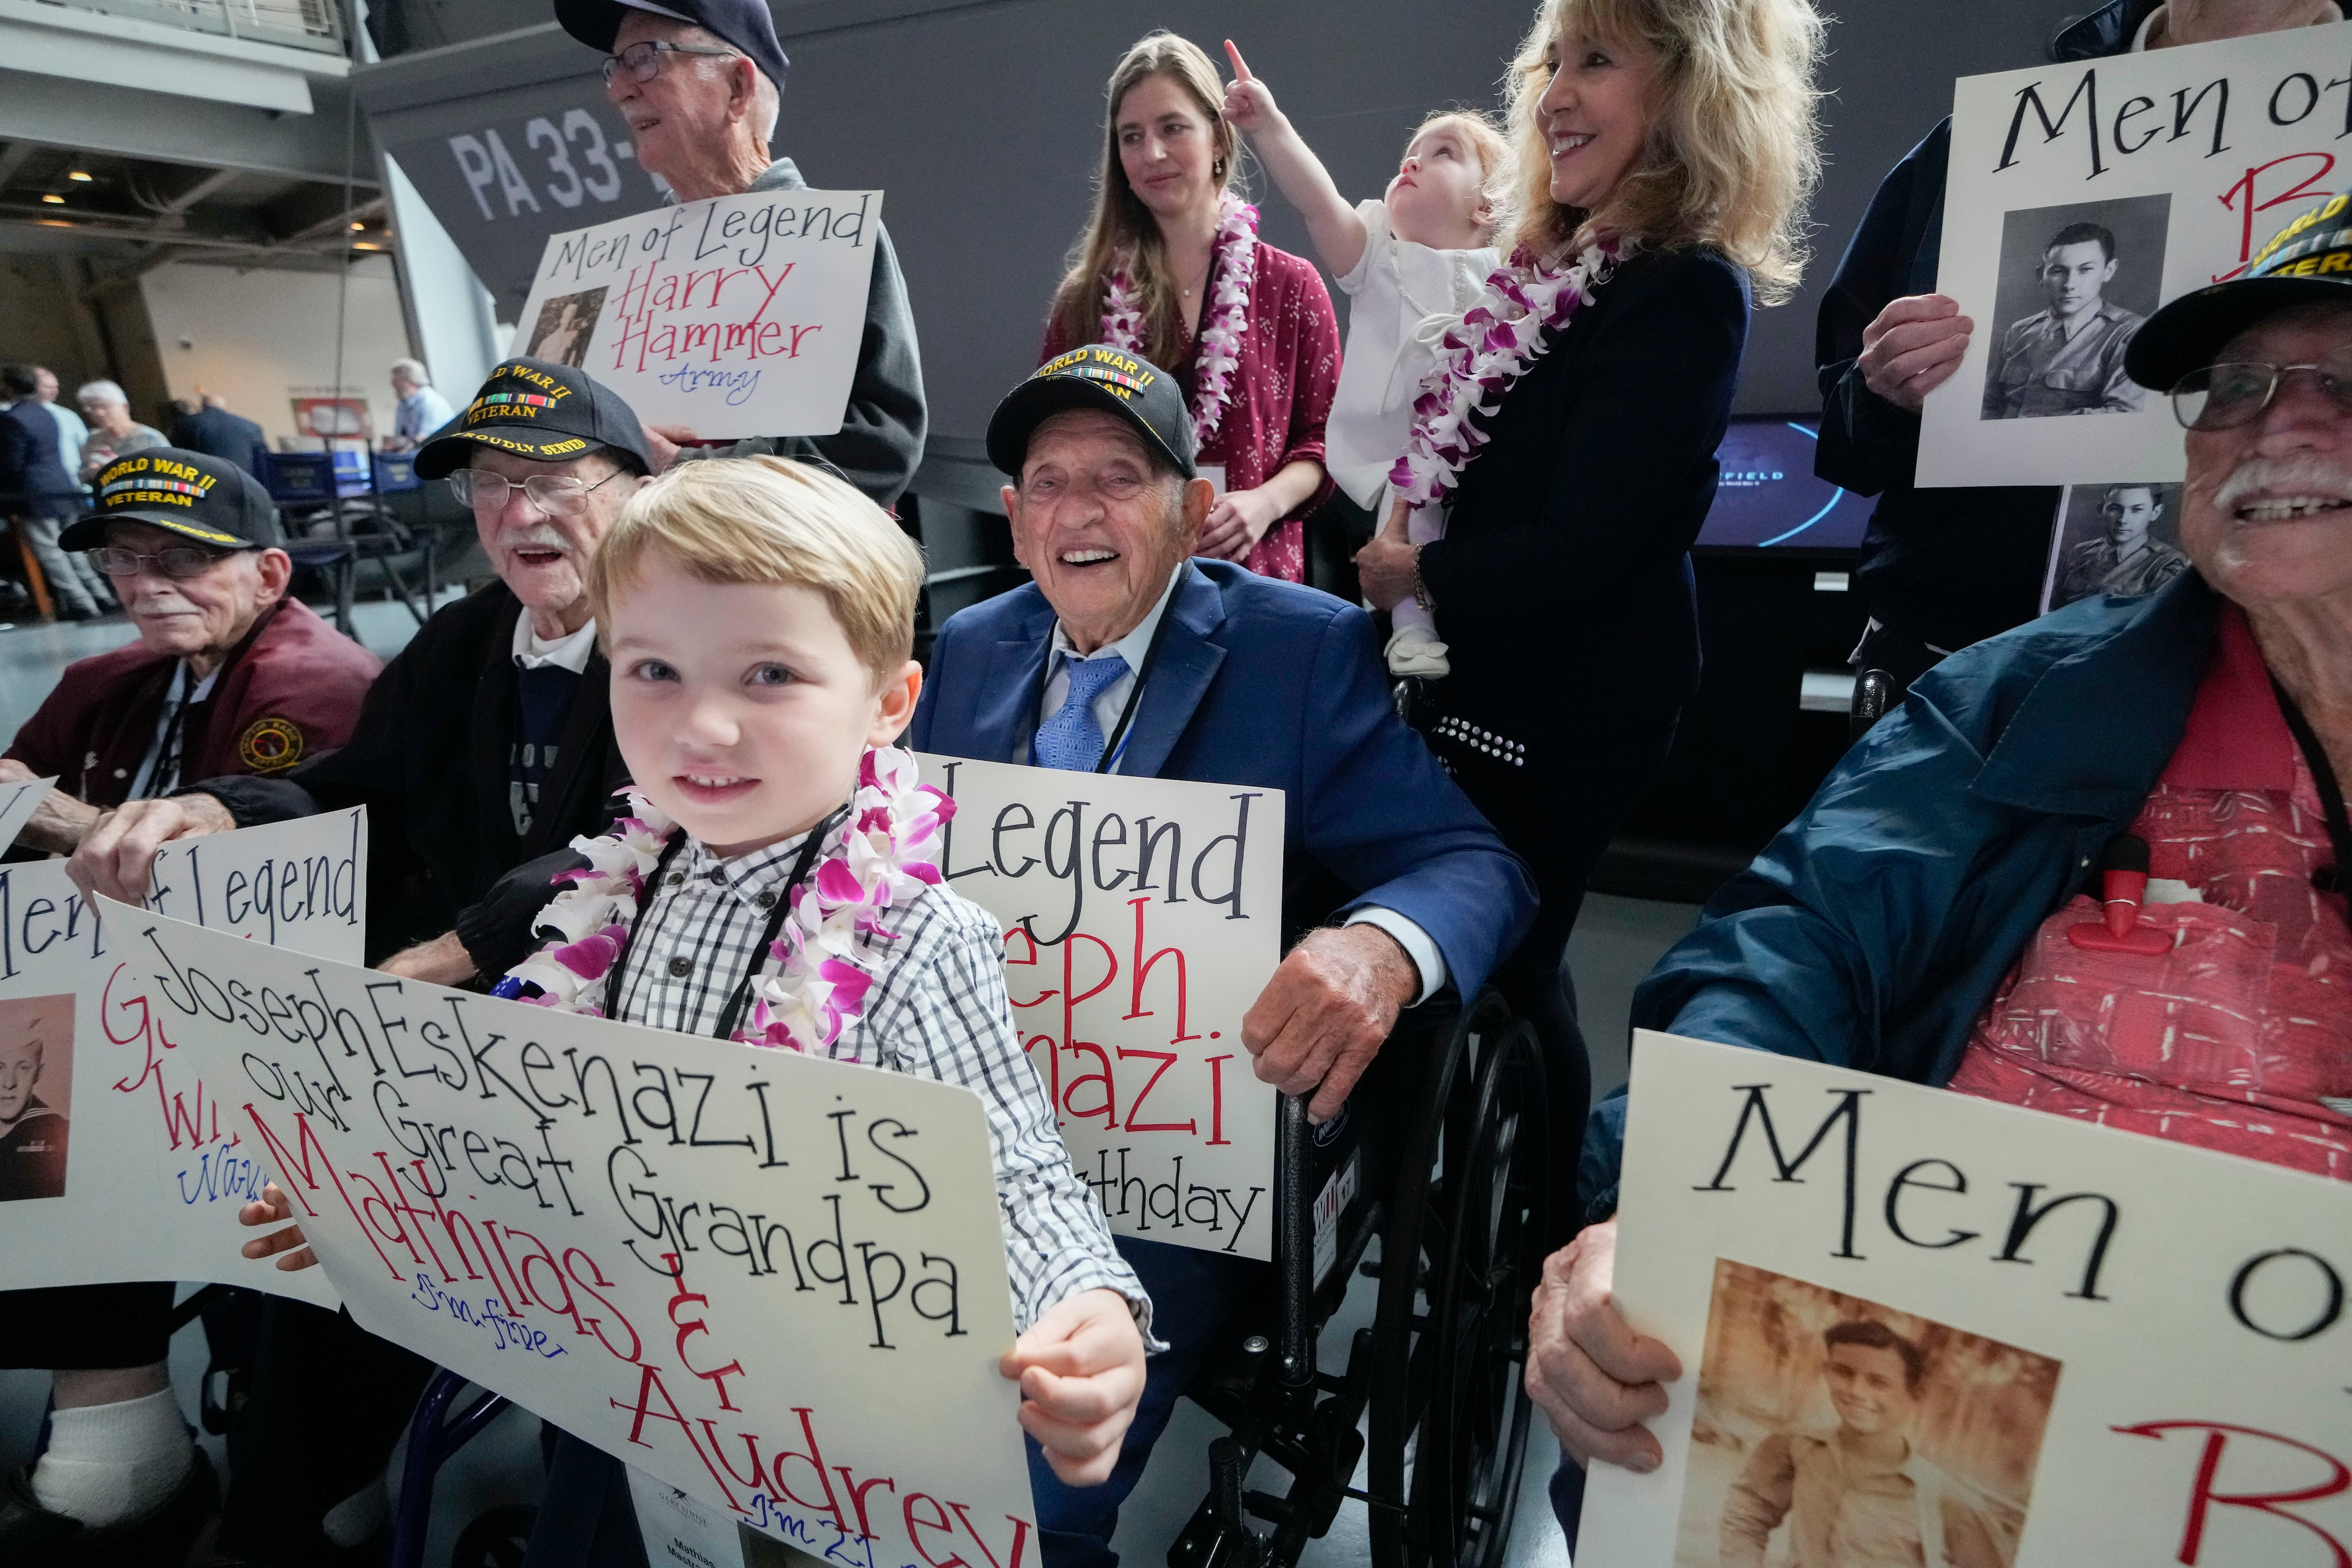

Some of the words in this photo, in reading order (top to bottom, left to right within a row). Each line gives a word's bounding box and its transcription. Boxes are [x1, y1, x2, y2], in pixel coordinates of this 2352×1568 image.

[1993, 69, 2230, 180] Men
[448, 128, 542, 220] PA
[527, 108, 671, 208] 33-
[546, 231, 631, 281] Men
[642, 207, 686, 262] of
[695, 194, 871, 267] Legend
[612, 259, 796, 328] Harry
[612, 310, 823, 373] Hammer
[1095, 349, 1138, 375] WAR
[1139, 371, 1155, 386] II
[468, 405, 537, 425] VETERAN
[513, 365, 555, 389] WAR
[550, 385, 572, 399] II
[660, 363, 762, 406] Army
[99, 457, 149, 487] WORLD
[153, 458, 199, 481] WAR
[199, 475, 217, 490] II
[452, 432, 535, 453] PROUDLY
[539, 438, 587, 455] SERVED
[1720, 471, 1784, 480] FIELD
[106, 491, 192, 507] VETERAN
[942, 762, 1263, 946] Legend
[1003, 897, 1201, 1050] eph
[143, 927, 386, 1100] Joseph
[365, 981, 788, 1168] Eskenazi
[826, 1095, 930, 1212] is
[1017, 1029, 1235, 1146] nazi
[242, 1053, 351, 1131] our
[373, 1080, 583, 1215] Great
[608, 1146, 967, 1348] Grandpa
[242, 1103, 641, 1363] Mathias
[1075, 1148, 1266, 1252] thday
[1692, 1084, 2120, 1302] Men
[2227, 1247, 2344, 1341] o
[481, 1299, 568, 1358] five
[610, 1362, 1031, 1568] Audrey
[674, 1537, 716, 1568] Mathias
